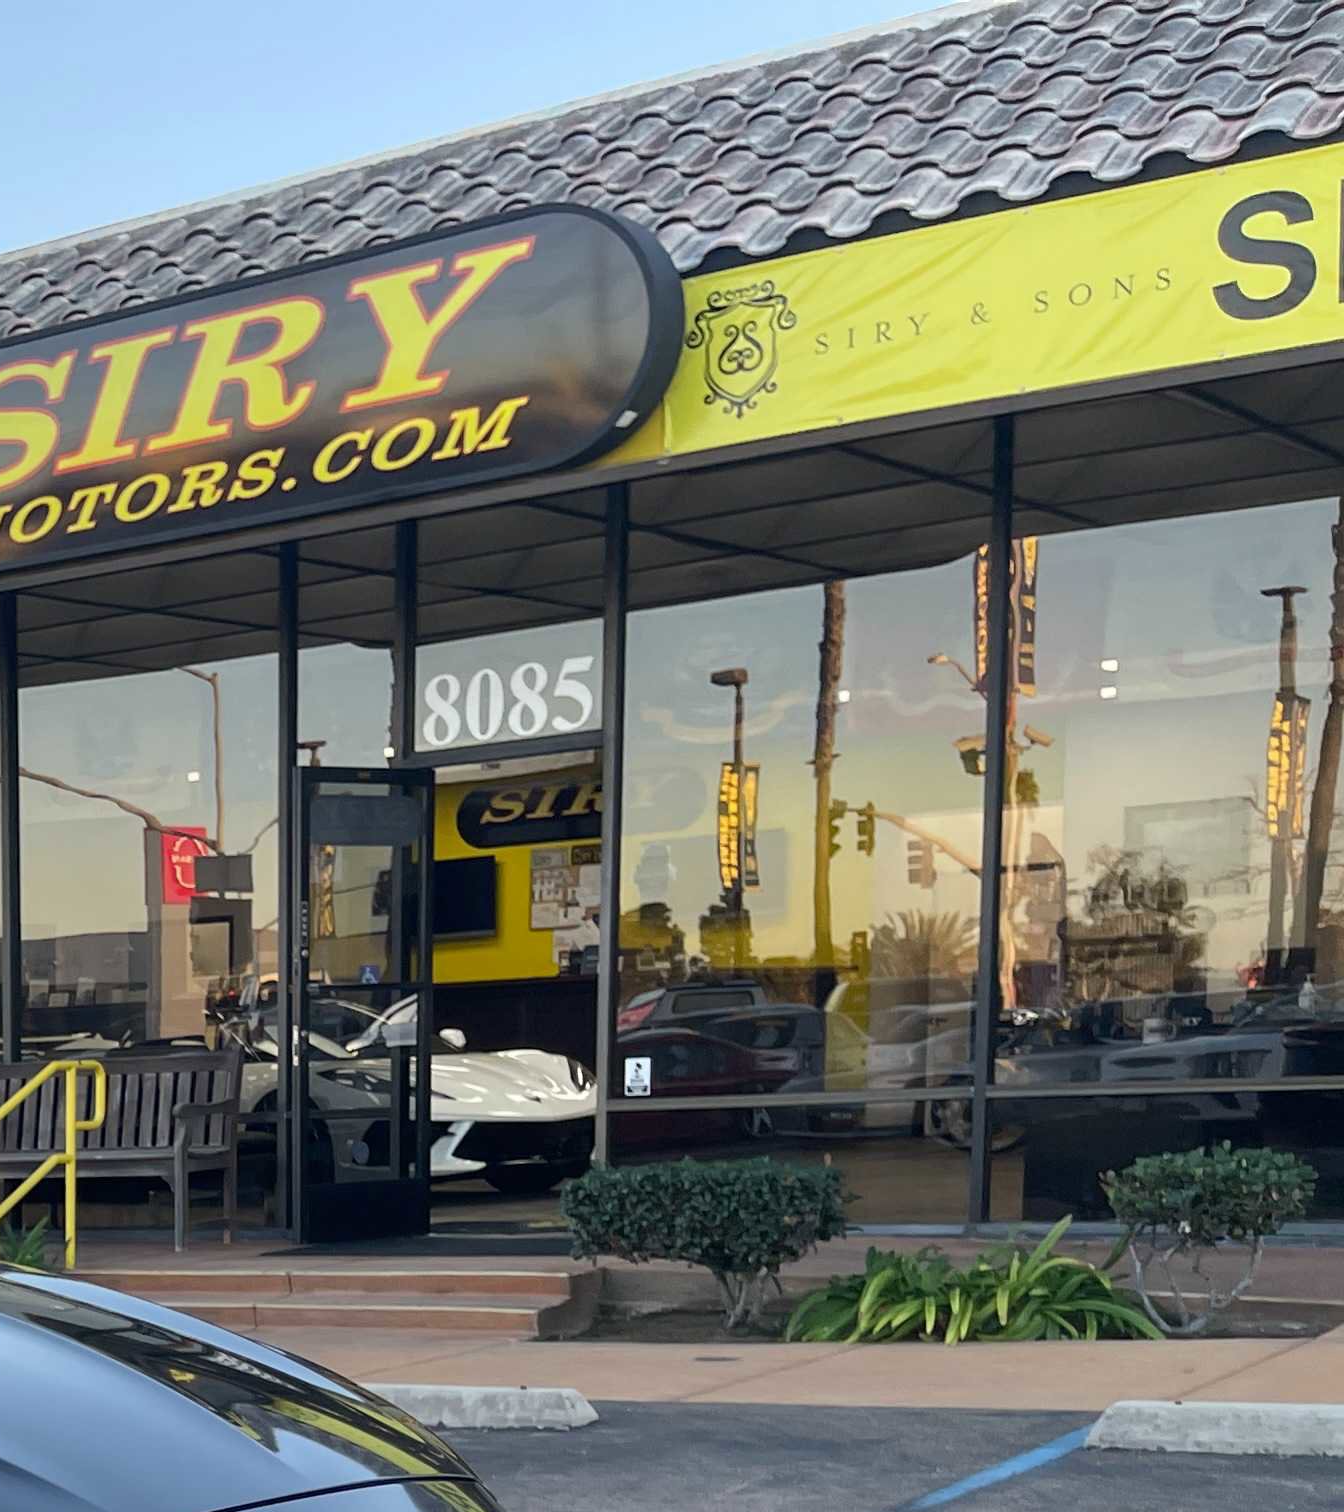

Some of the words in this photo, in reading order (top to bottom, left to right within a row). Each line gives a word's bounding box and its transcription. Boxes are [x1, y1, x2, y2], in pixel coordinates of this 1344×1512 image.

[1212, 188, 1344, 321] S
[815, 312, 931, 356] SIRY
[970, 301, 990, 326] &
[1033, 267, 1174, 314] SONS
[423, 656, 594, 746] 8085
